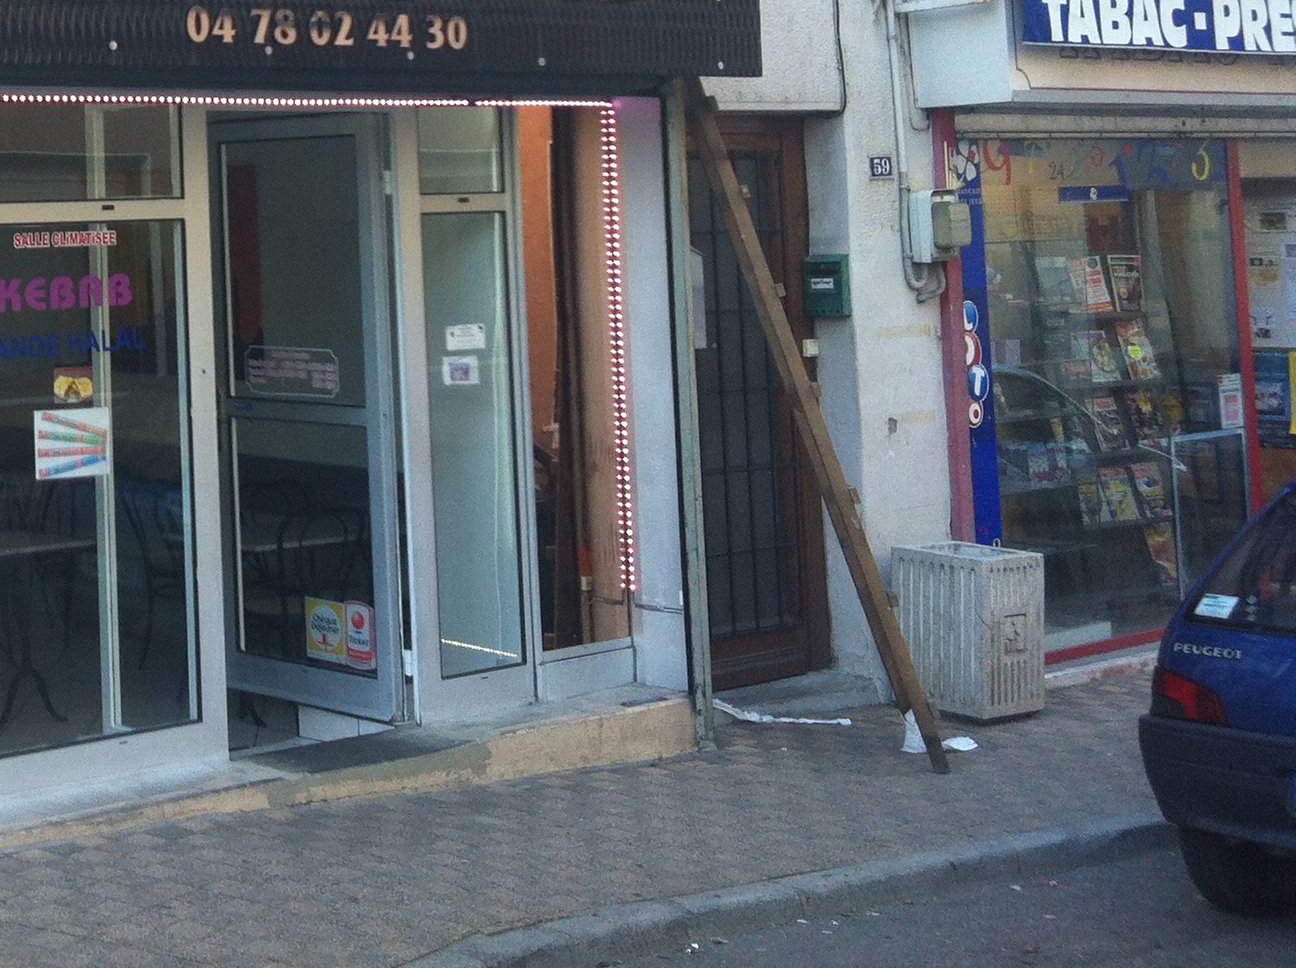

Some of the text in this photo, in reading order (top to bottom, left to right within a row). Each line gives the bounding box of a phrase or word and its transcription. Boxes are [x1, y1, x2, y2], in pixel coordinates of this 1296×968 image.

[186, 5, 236, 45] 04
[249, 7, 297, 46] 78
[366, 11, 413, 49] 44
[425, 13, 467, 51] 30
[873, 159, 891, 176] 59
[13, 232, 50, 249] SALLE
[67, 327, 146, 355] HALAL
[1173, 642, 1243, 660] PEUGEOT
